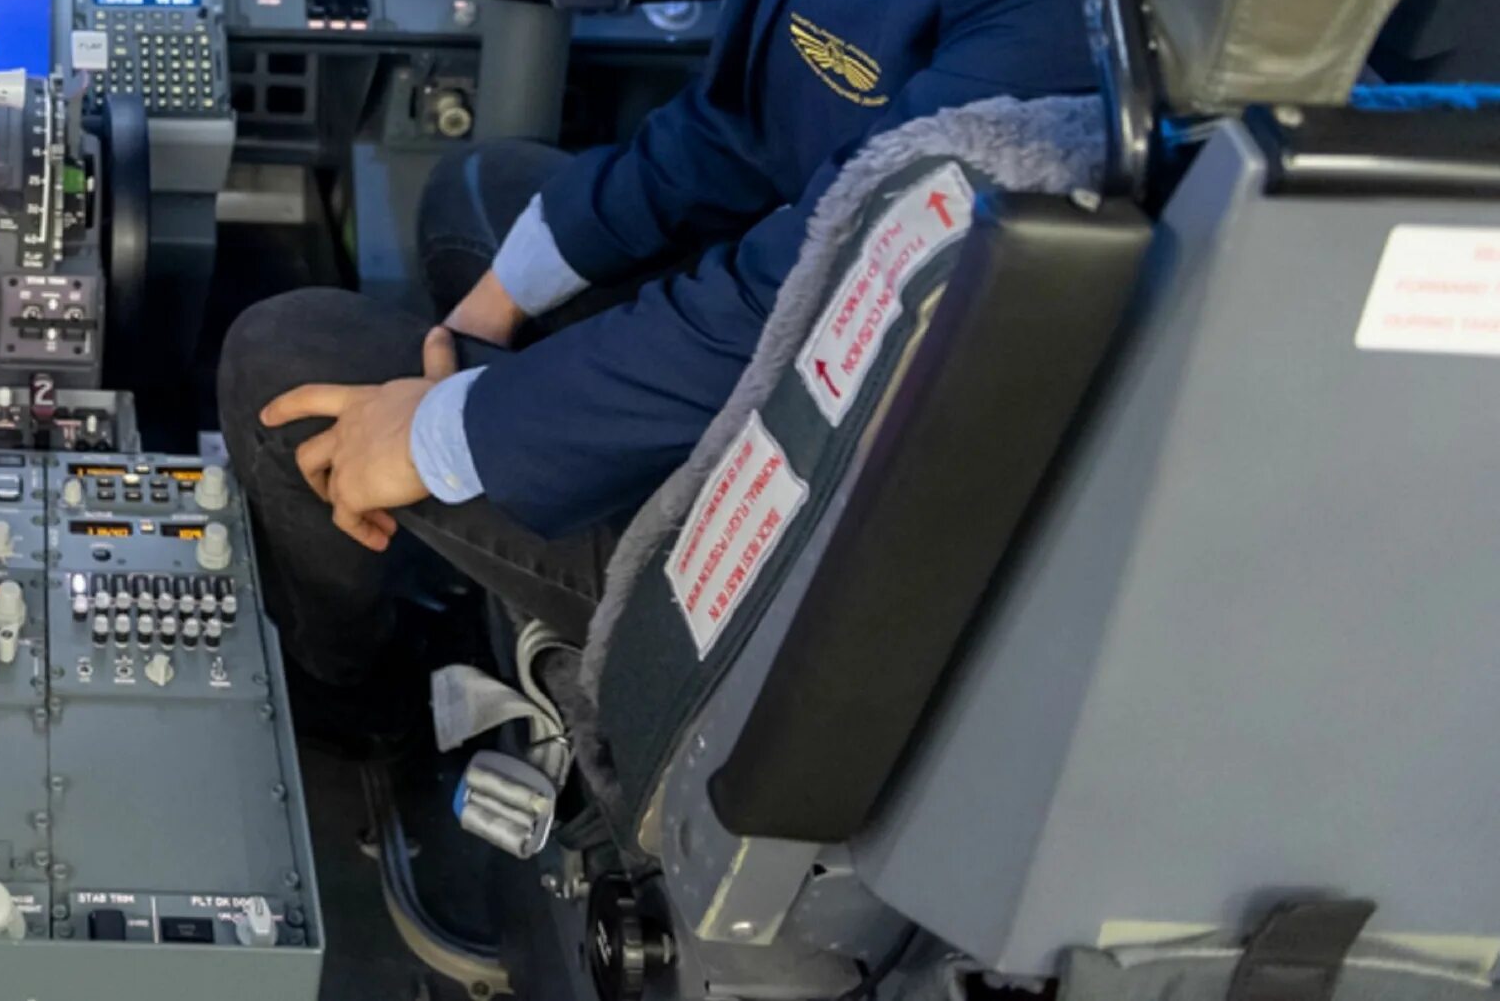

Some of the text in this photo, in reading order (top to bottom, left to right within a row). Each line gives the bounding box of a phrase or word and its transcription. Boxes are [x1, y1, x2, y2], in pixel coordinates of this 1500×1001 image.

[33, 380, 54, 405] 2
[744, 455, 782, 504] NORMAL
[77, 892, 136, 904] STAB TRIM
[190, 895, 213, 907] FLT
